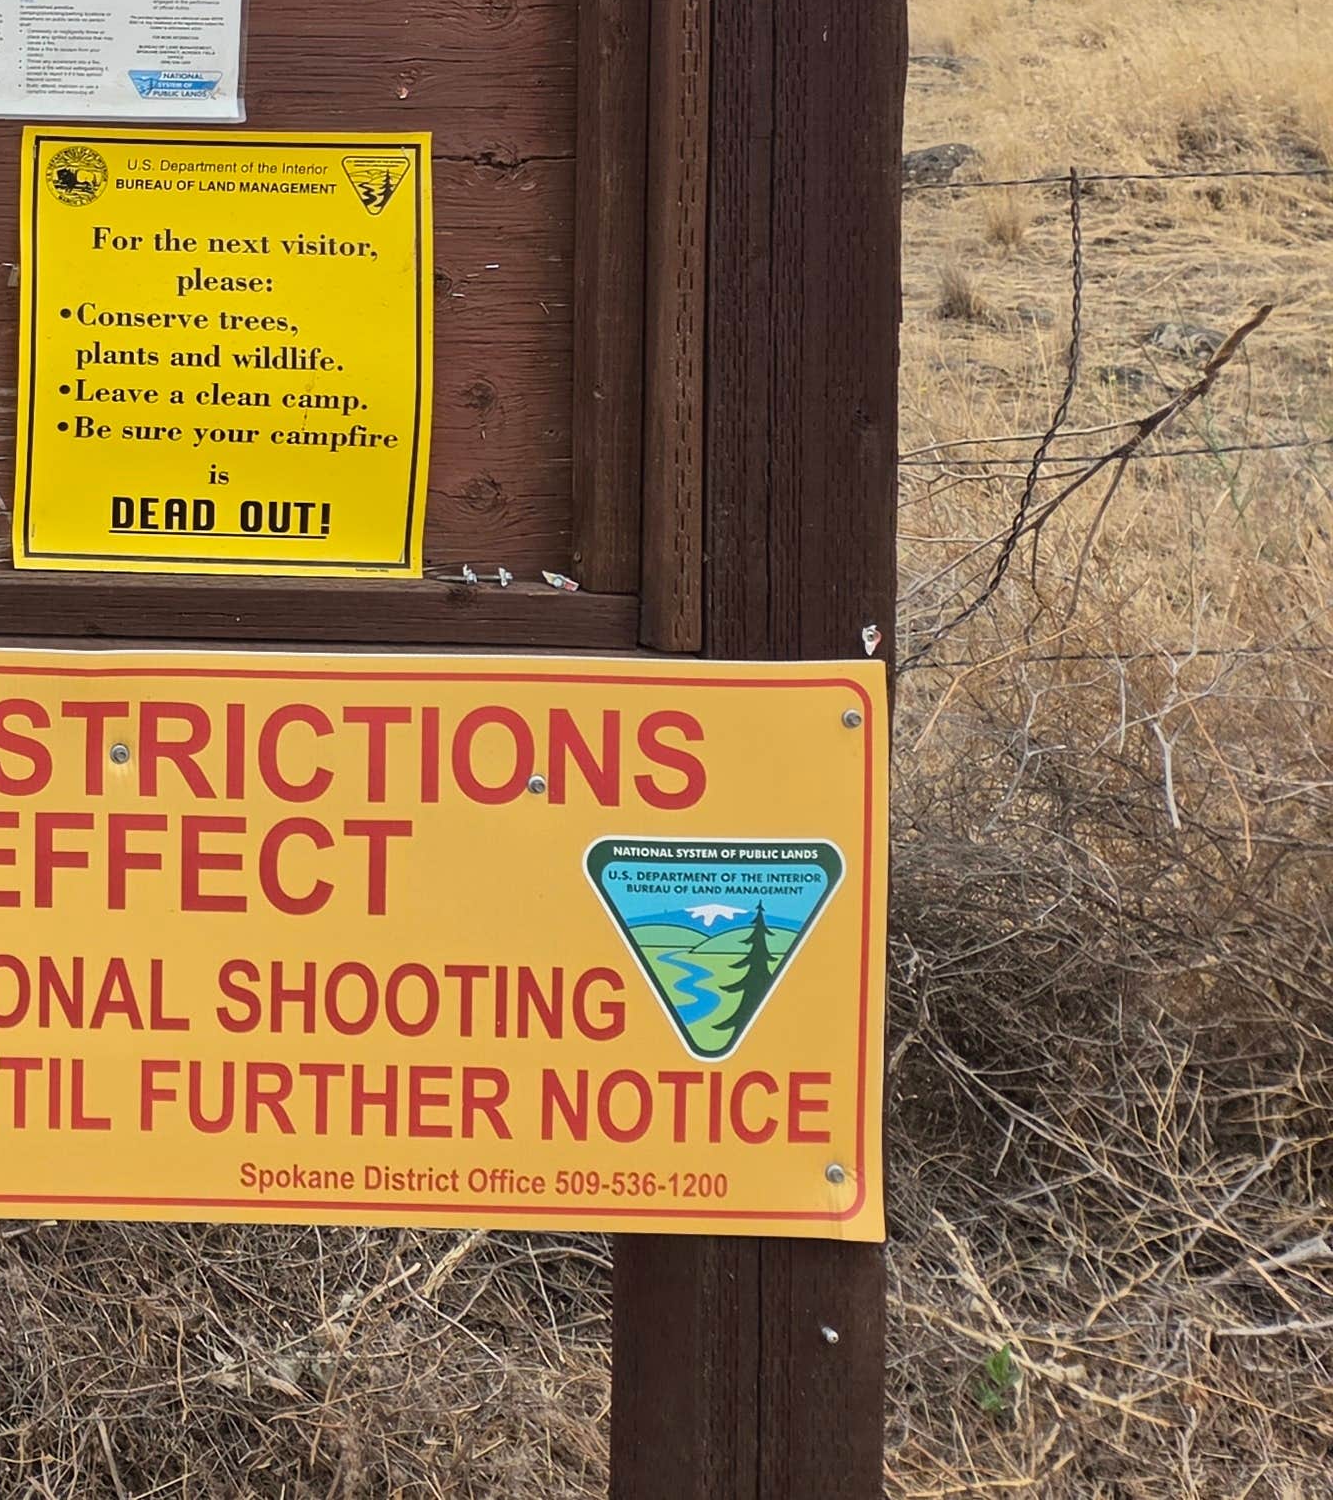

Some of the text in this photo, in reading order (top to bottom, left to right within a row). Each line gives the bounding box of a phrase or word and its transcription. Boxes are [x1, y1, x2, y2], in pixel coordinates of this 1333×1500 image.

[92, 226, 379, 260] For the next visitor,
[176, 269, 273, 296] please:
[77, 303, 299, 335] Conserve trees,
[75, 343, 344, 372] plants and wildlife.
[75, 380, 368, 415] Leave a clean camp.
[74, 417, 399, 452] Be sure your campfire
[209, 464, 229, 484] is
[111, 497, 331, 534] DEAD OUT!
[613, 847, 818, 859] NATIONAL SYSTEM OF PUBLIC LANDS
[609, 871, 821, 882] U.S. DEPARTMENT OF THE INTERIOR
[627, 885, 671, 893] BUREAU
[692, 886, 721, 894] LAND
[725, 886, 803, 895] MANAGEMENT
[218, 959, 626, 1041] SHOOTING
[140, 1058, 512, 1140] FURTHER
[541, 1068, 831, 1144] NOTICE
[240, 1163, 727, 1198] Spokane District Office 509-536-1200
